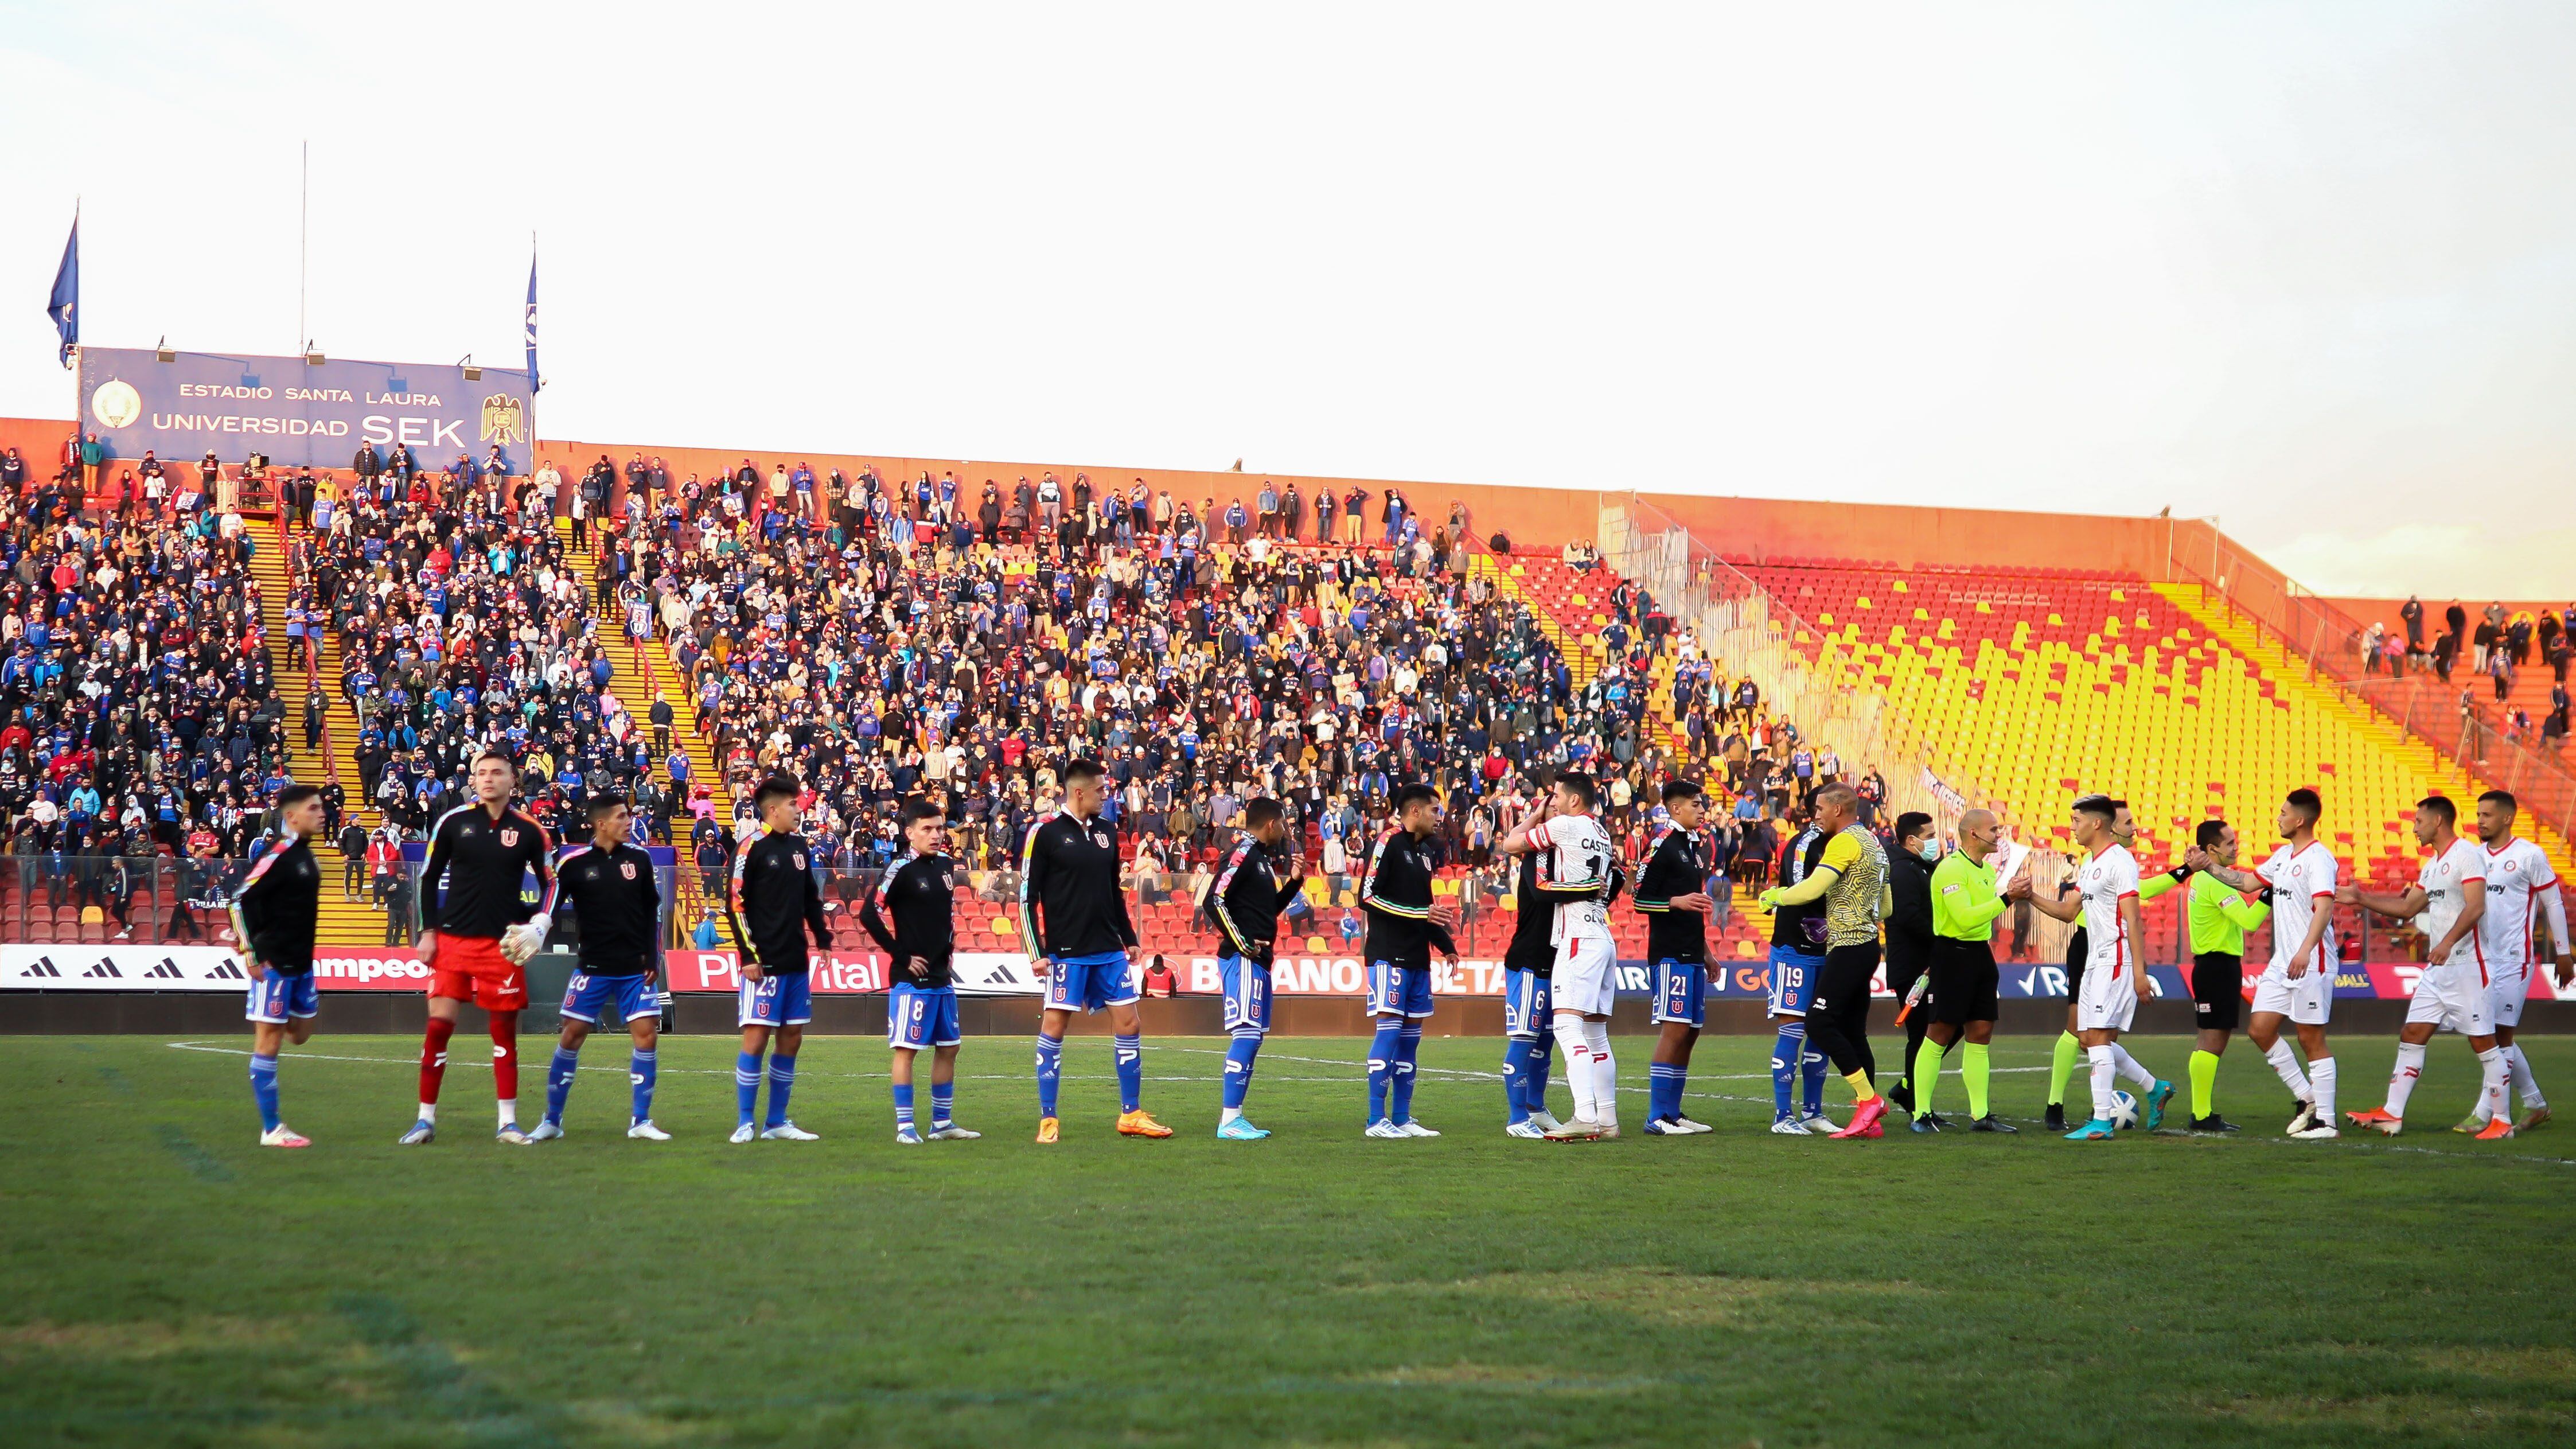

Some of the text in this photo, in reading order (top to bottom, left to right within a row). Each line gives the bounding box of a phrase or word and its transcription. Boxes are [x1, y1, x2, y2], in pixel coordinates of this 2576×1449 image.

[180, 384, 441, 407] ESTADIO SANTA LAURA
[153, 413, 466, 448] UNIVERSIDAD SEK
[2487, 885, 2506, 895] way
[313, 958, 429, 982] mpeo
[1056, 964, 1067, 983] 3
[1391, 968, 1401, 986] 5
[1786, 967, 1803, 988] 19
[756, 976, 778, 997] 23
[1670, 975, 1686, 996] 21
[913, 1000, 924, 1021] 8
[1536, 990, 1545, 1010] 6
